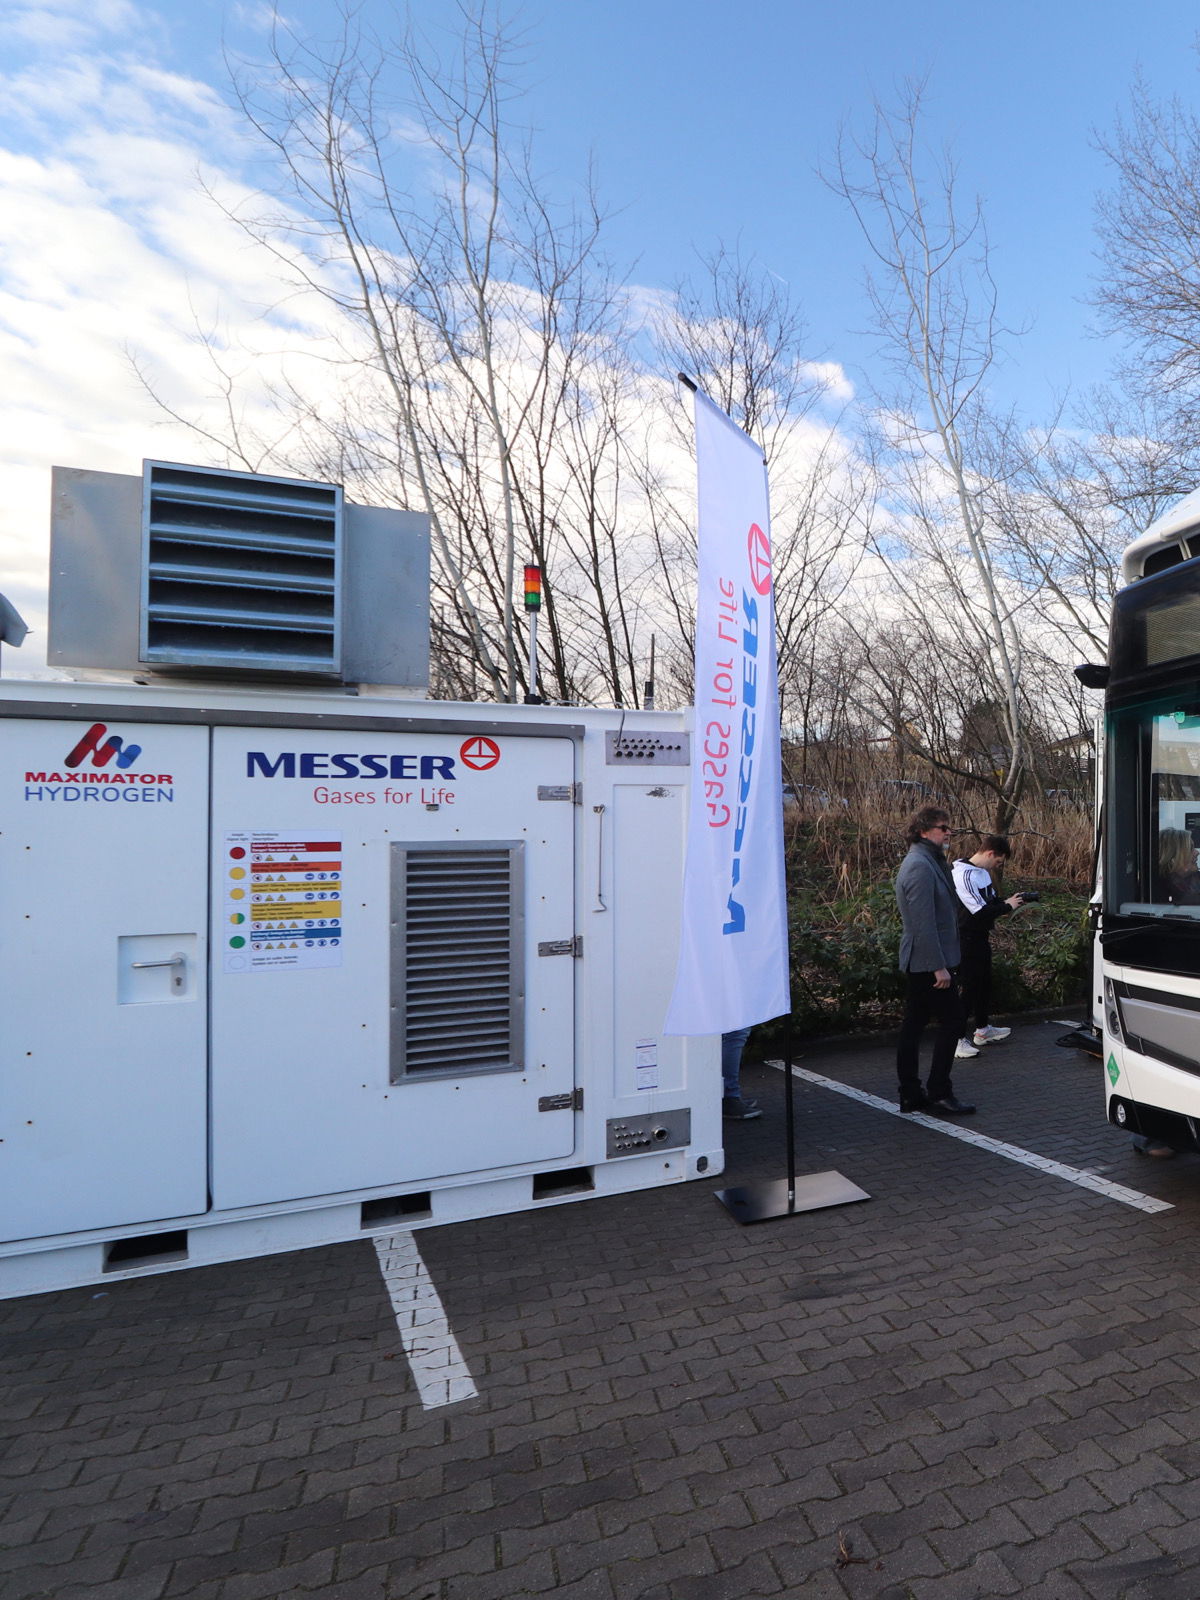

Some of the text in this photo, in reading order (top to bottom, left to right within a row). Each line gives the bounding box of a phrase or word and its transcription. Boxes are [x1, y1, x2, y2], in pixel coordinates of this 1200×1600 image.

[247, 752, 457, 780] MESSER
[25, 772, 173, 784] MAXIMATOR
[25, 786, 173, 802] HYDROGEN
[313, 787, 455, 805] Gases for Life
